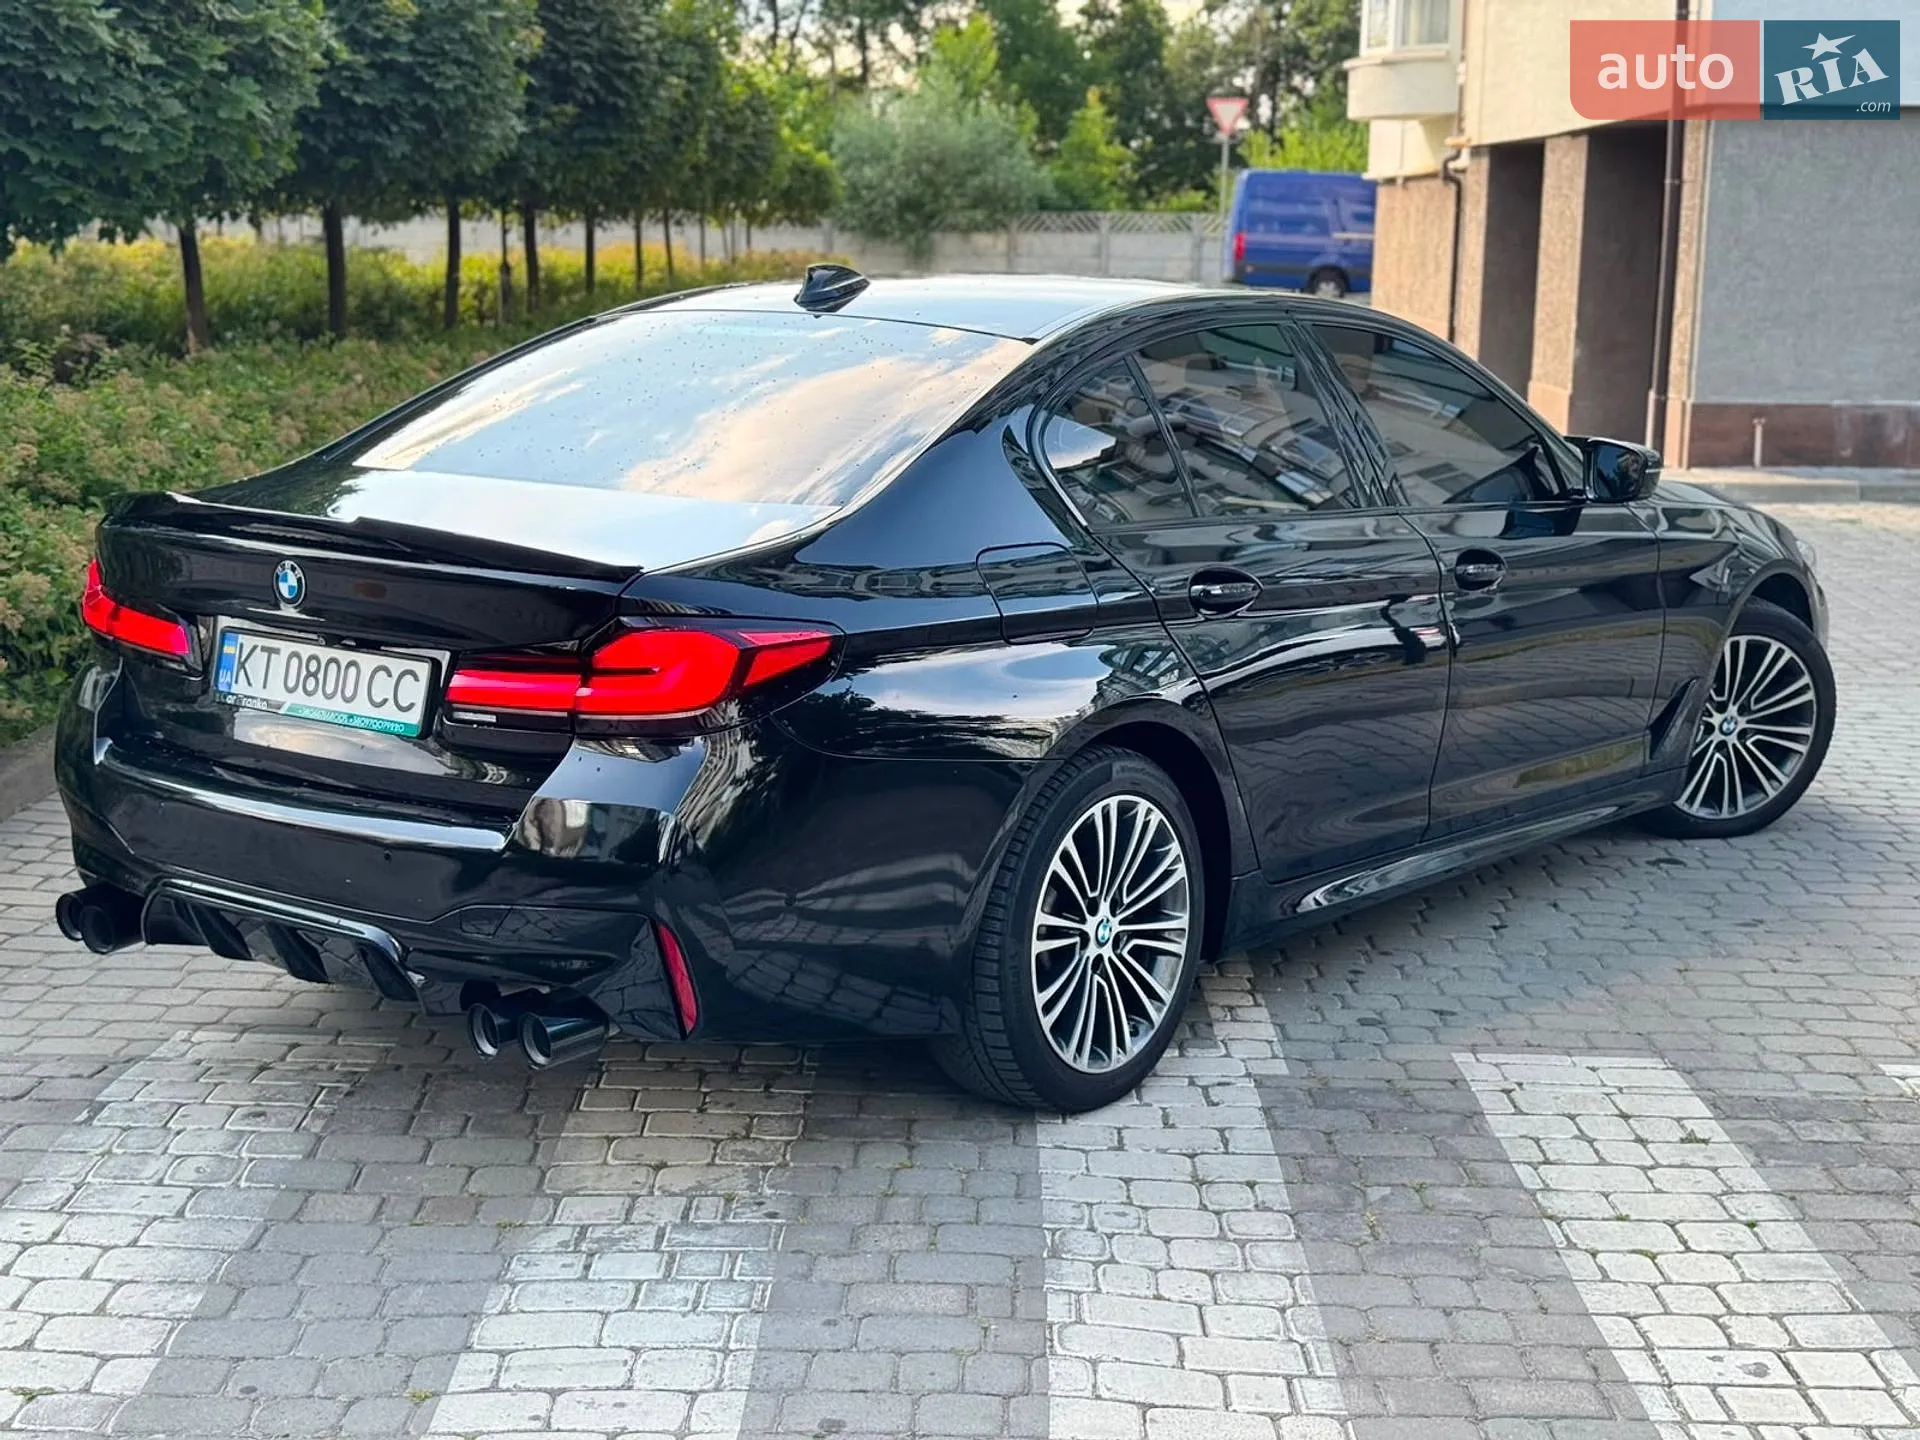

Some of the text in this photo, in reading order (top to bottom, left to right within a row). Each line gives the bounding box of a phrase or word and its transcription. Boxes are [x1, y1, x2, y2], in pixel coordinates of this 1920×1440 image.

[219, 668, 232, 684] UA
[234, 642, 420, 713] KT 0800 CC
